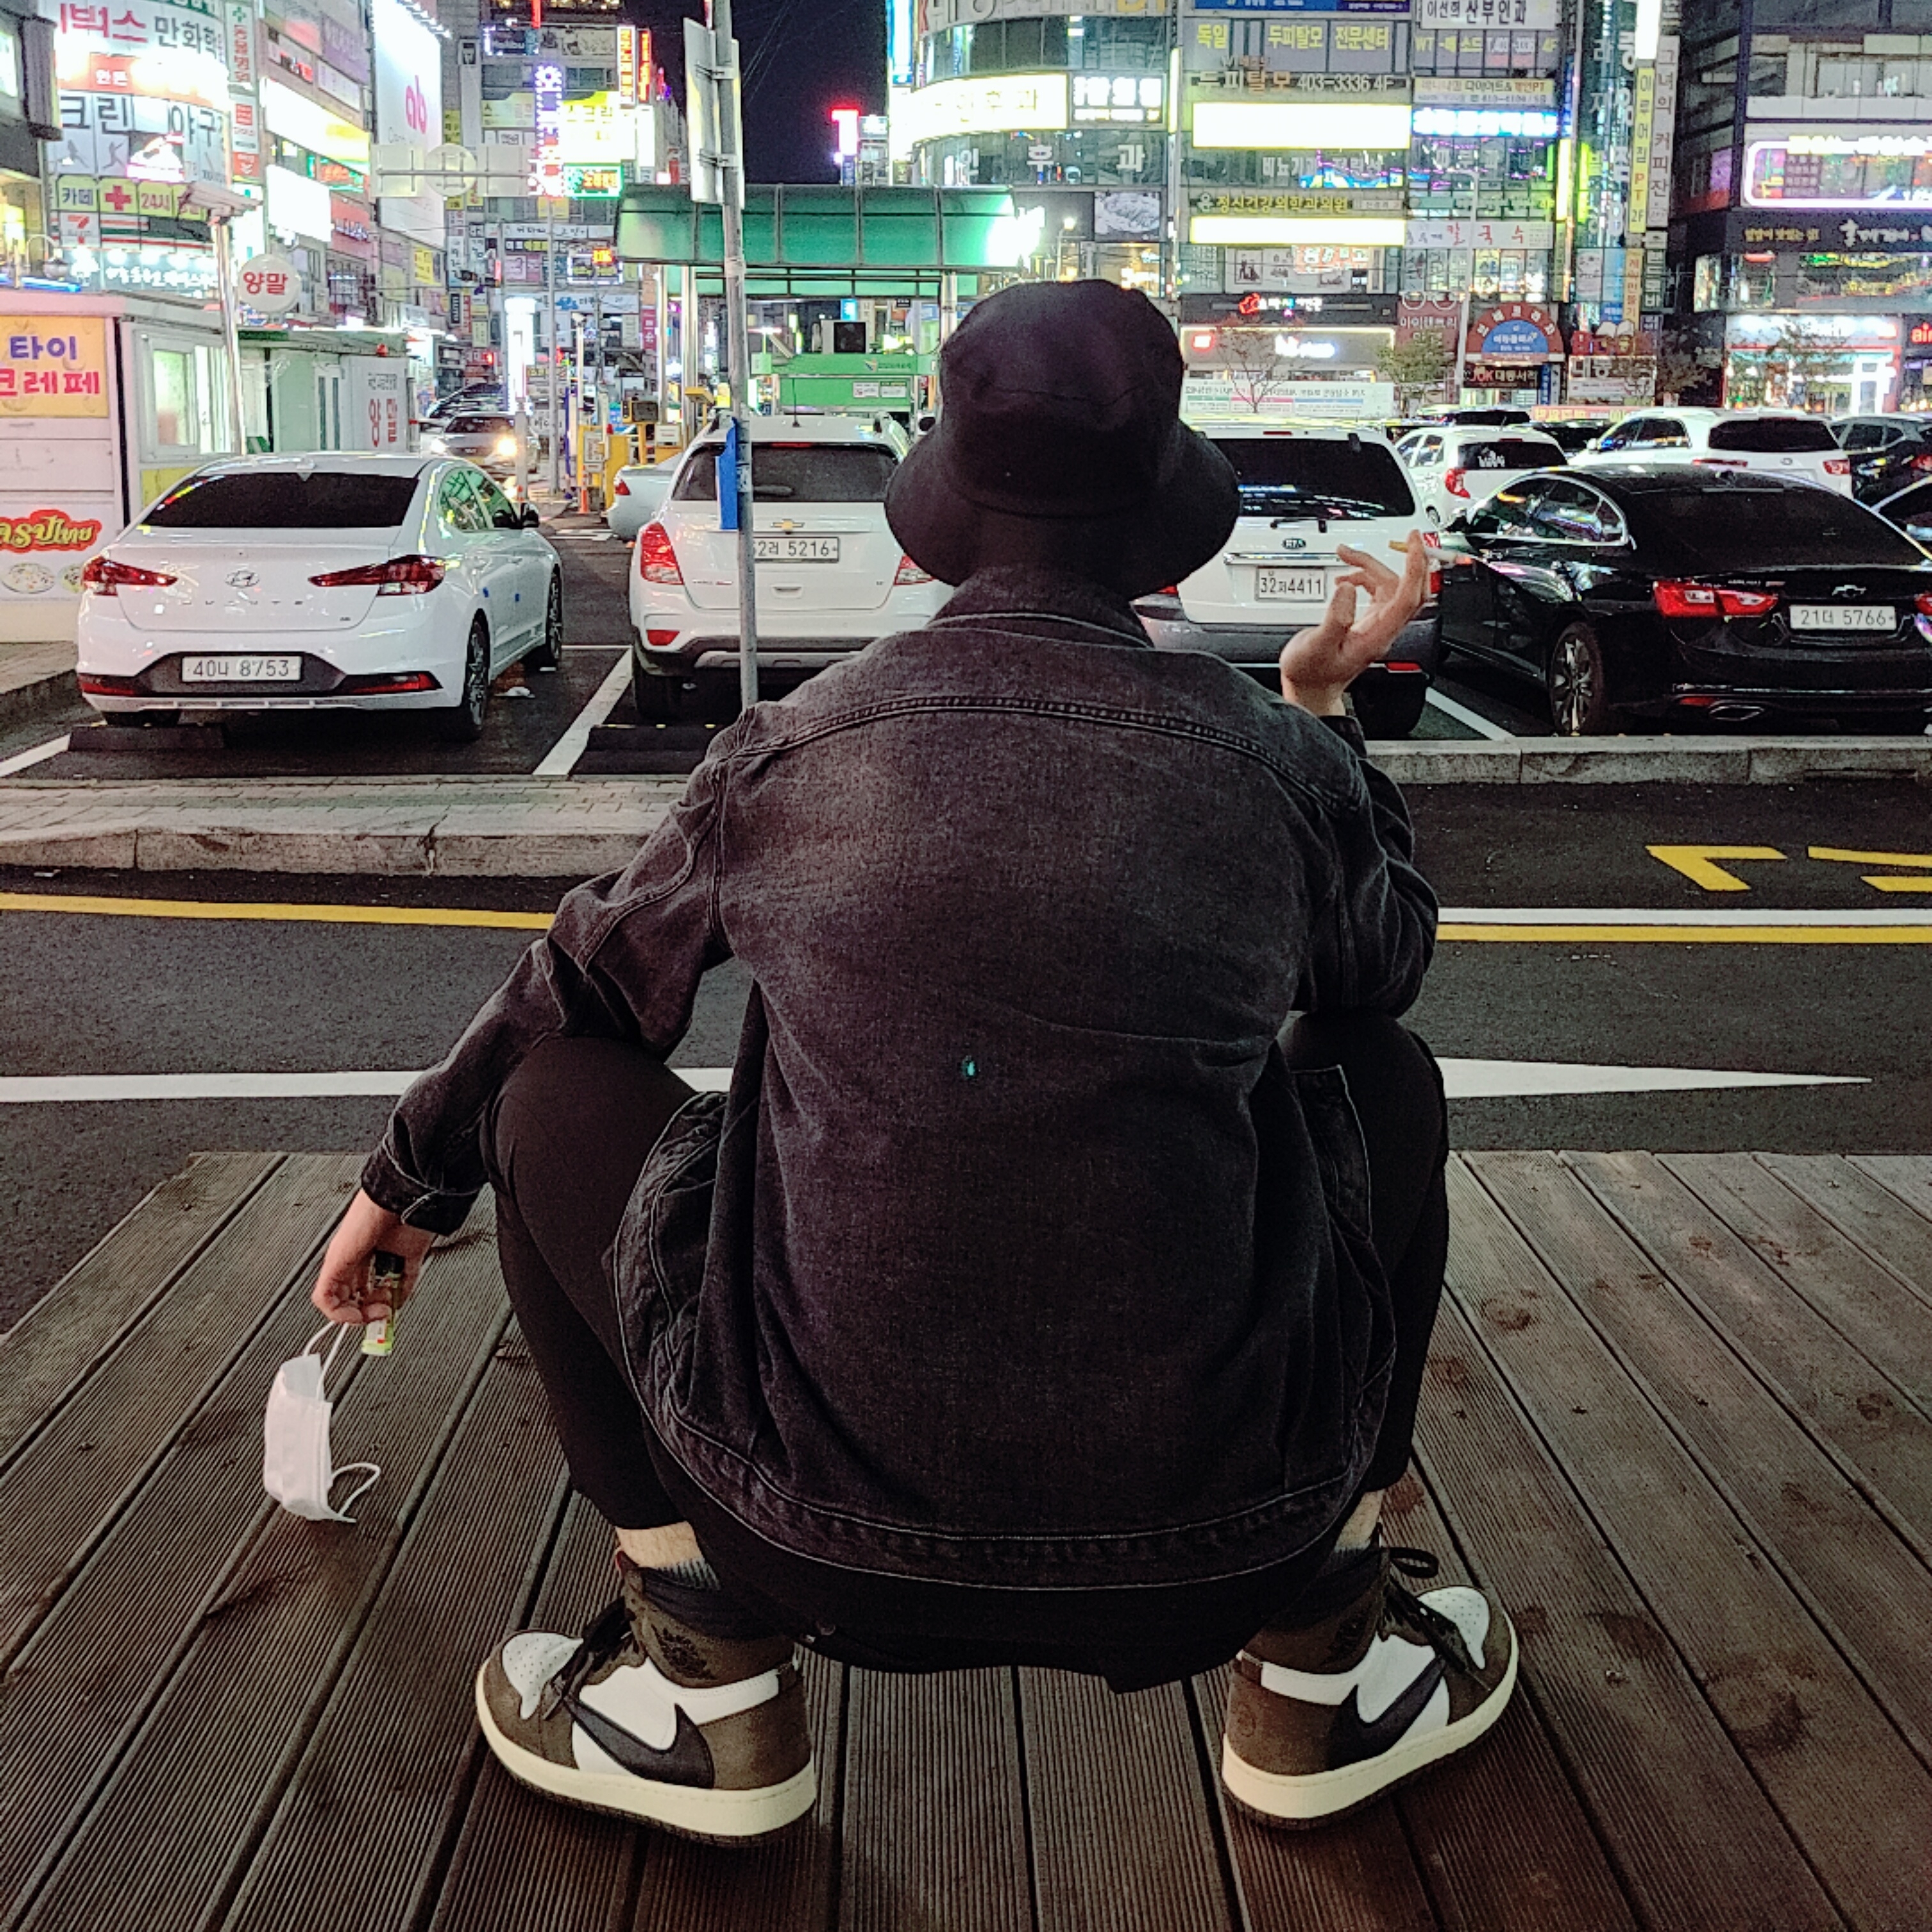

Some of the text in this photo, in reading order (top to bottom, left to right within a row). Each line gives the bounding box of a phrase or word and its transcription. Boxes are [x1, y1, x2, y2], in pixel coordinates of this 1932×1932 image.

[1197, 24, 1390, 50] 독일 두피탈모 전문센터
[1297, 73, 1370, 92] 403-3336
[1630, 208, 1644, 223] 2F
[243, 272, 288, 295] 양말
[10, 336, 77, 360] 타이
[788, 540, 829, 556] 5216
[1843, 610, 1886, 626] 5766
[192, 659, 289, 678] 40너 8753
